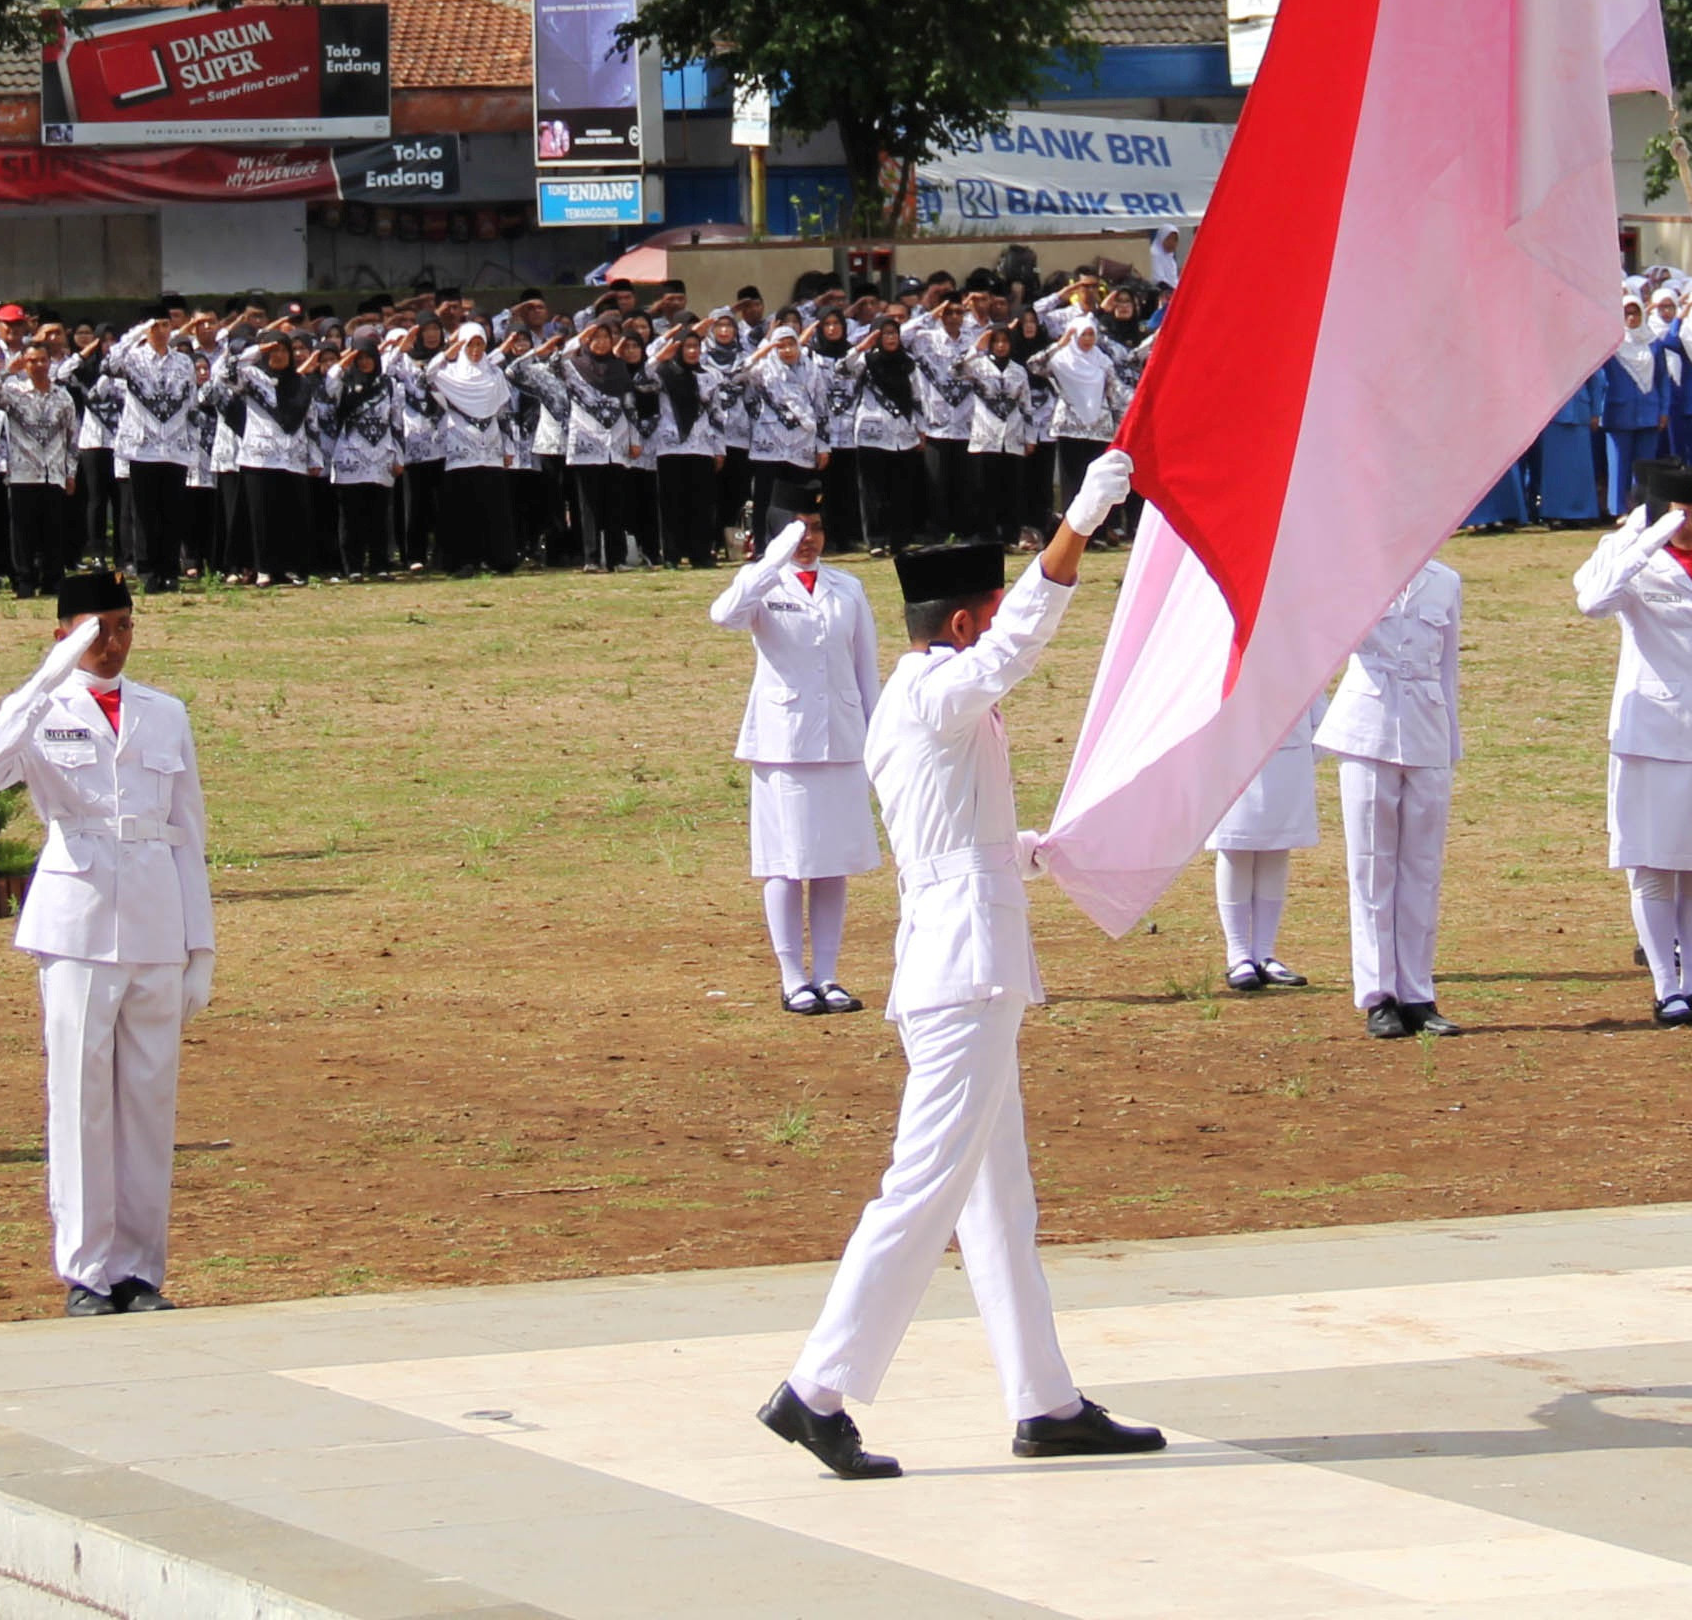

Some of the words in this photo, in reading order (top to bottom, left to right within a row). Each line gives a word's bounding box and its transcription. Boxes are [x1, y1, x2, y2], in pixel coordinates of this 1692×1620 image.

[169, 20, 274, 63] DJARUM
[325, 43, 362, 58] Toko
[179, 49, 263, 90] SUPER
[325, 59, 382, 76] Endang
[207, 80, 265, 102] Superfine
[392, 144, 444, 161] Toko
[991, 126, 1102, 163] BANK
[1105, 133, 1173, 168] BRI
[365, 168, 444, 189] Endang
[568, 182, 635, 202] ENDANG
[1006, 186, 1114, 217] BANK
